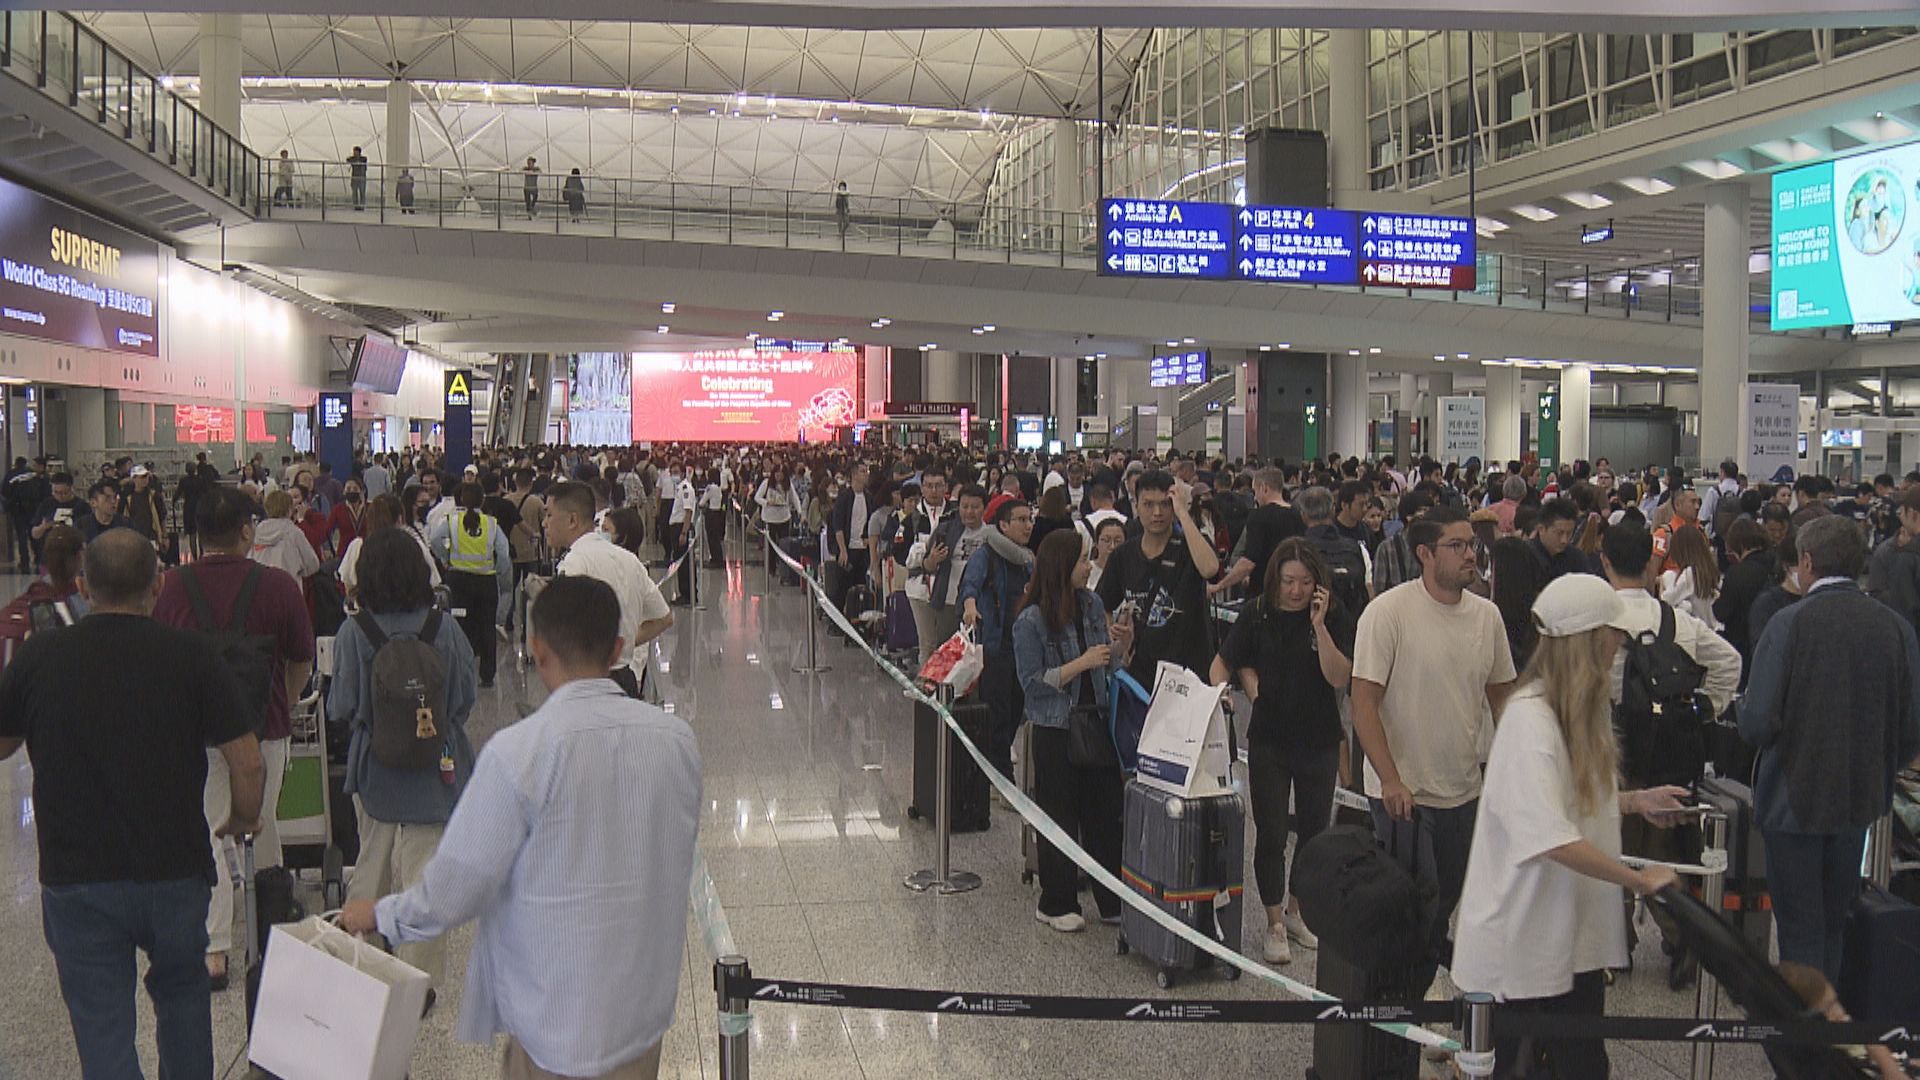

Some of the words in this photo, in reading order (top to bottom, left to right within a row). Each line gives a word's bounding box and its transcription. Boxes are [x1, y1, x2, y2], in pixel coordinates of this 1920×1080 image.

[1124, 212, 1152, 222] Arrivals
[1152, 213, 1167, 223] Hall
[1168, 204, 1183, 224] A
[1272, 220, 1283, 229] Car
[1284, 220, 1300, 230] Park
[1303, 212, 1315, 229] 4
[1778, 228, 1816, 244] WELCOME
[1196, 241, 1226, 251] Transport
[1778, 240, 1804, 254] HONG
[1804, 236, 1830, 251] KONG
[1394, 251, 1416, 261] Airport
[1416, 252, 1430, 261] Lost
[1437, 253, 1457, 262] Found
[1255, 268, 1277, 277] Airline
[3, 258, 33, 286] World
[34, 267, 57, 293] Class
[58, 274, 70, 296] 5G
[71, 278, 106, 308] Roaming
[1412, 275, 1433, 286] Airport
[1434, 276, 1450, 286] Hotel
[448, 372, 469, 395] A
[701, 375, 774, 393] Celebrating
[909, 403, 921, 413] PRET
[1753, 429, 1769, 437] Train
[1770, 429, 1792, 437] tickets
[1753, 443, 1764, 455] 24
